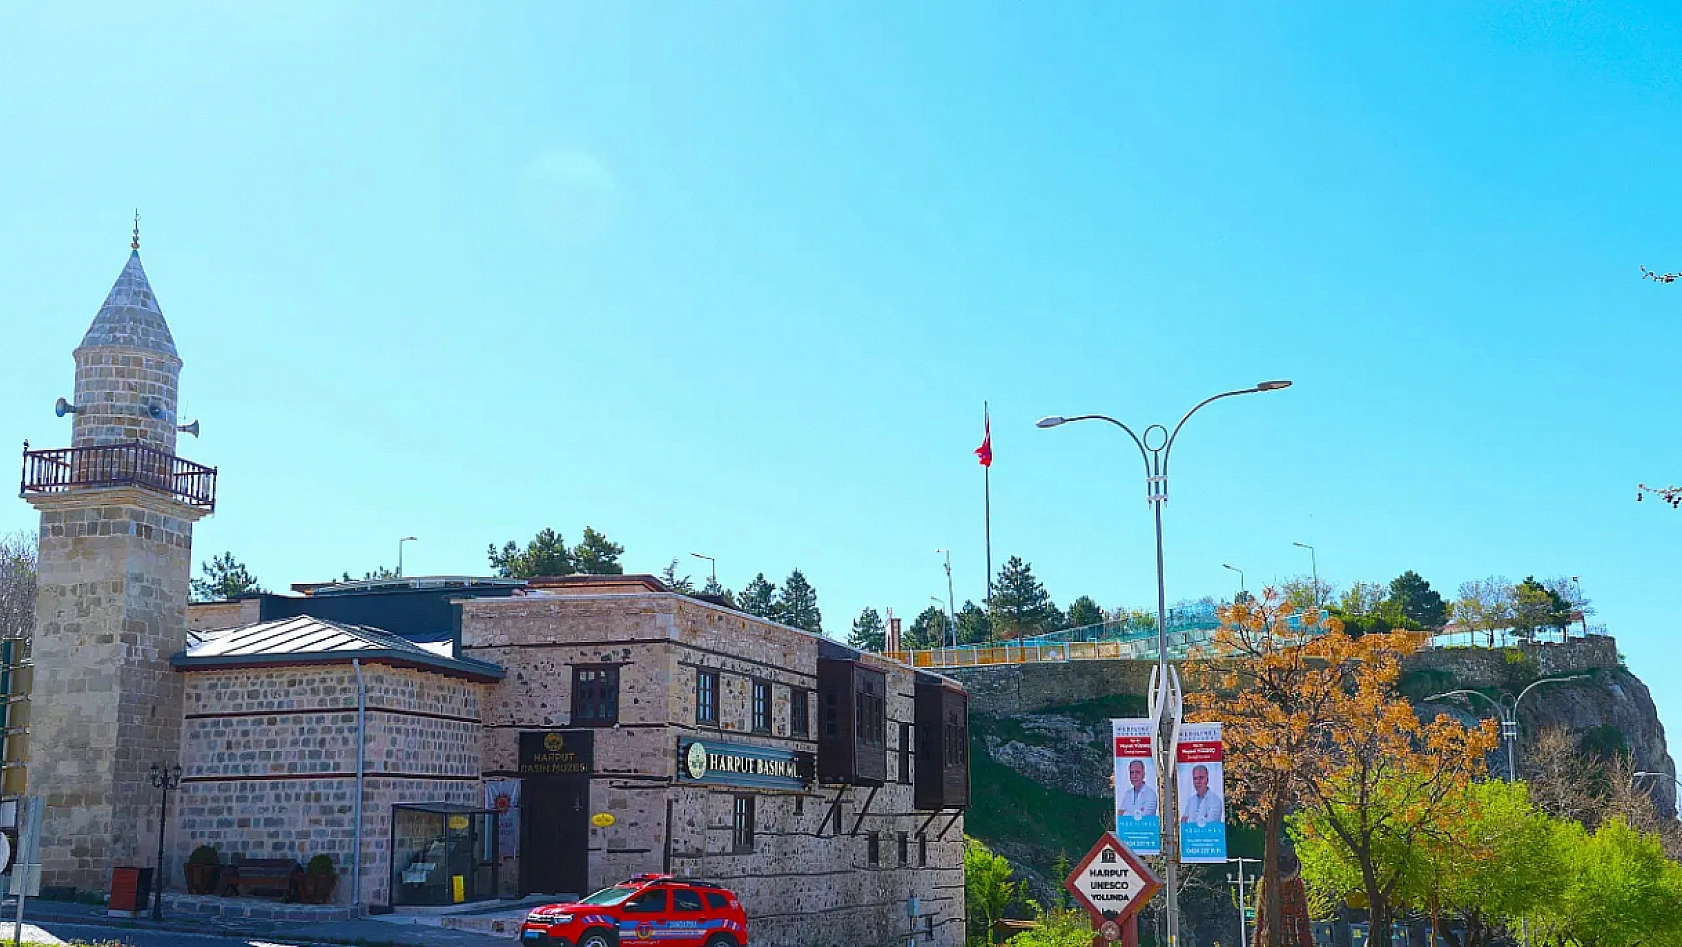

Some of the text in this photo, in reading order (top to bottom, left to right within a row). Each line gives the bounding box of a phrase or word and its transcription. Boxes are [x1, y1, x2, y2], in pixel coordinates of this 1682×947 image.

[534, 753, 576, 763] HARPUT
[709, 753, 755, 774] HARPUT
[756, 758, 785, 777] BASIN
[1090, 869, 1129, 877] HARPUT
[1091, 882, 1129, 890] UNESCO
[1091, 893, 1130, 901] YOLUNDA
